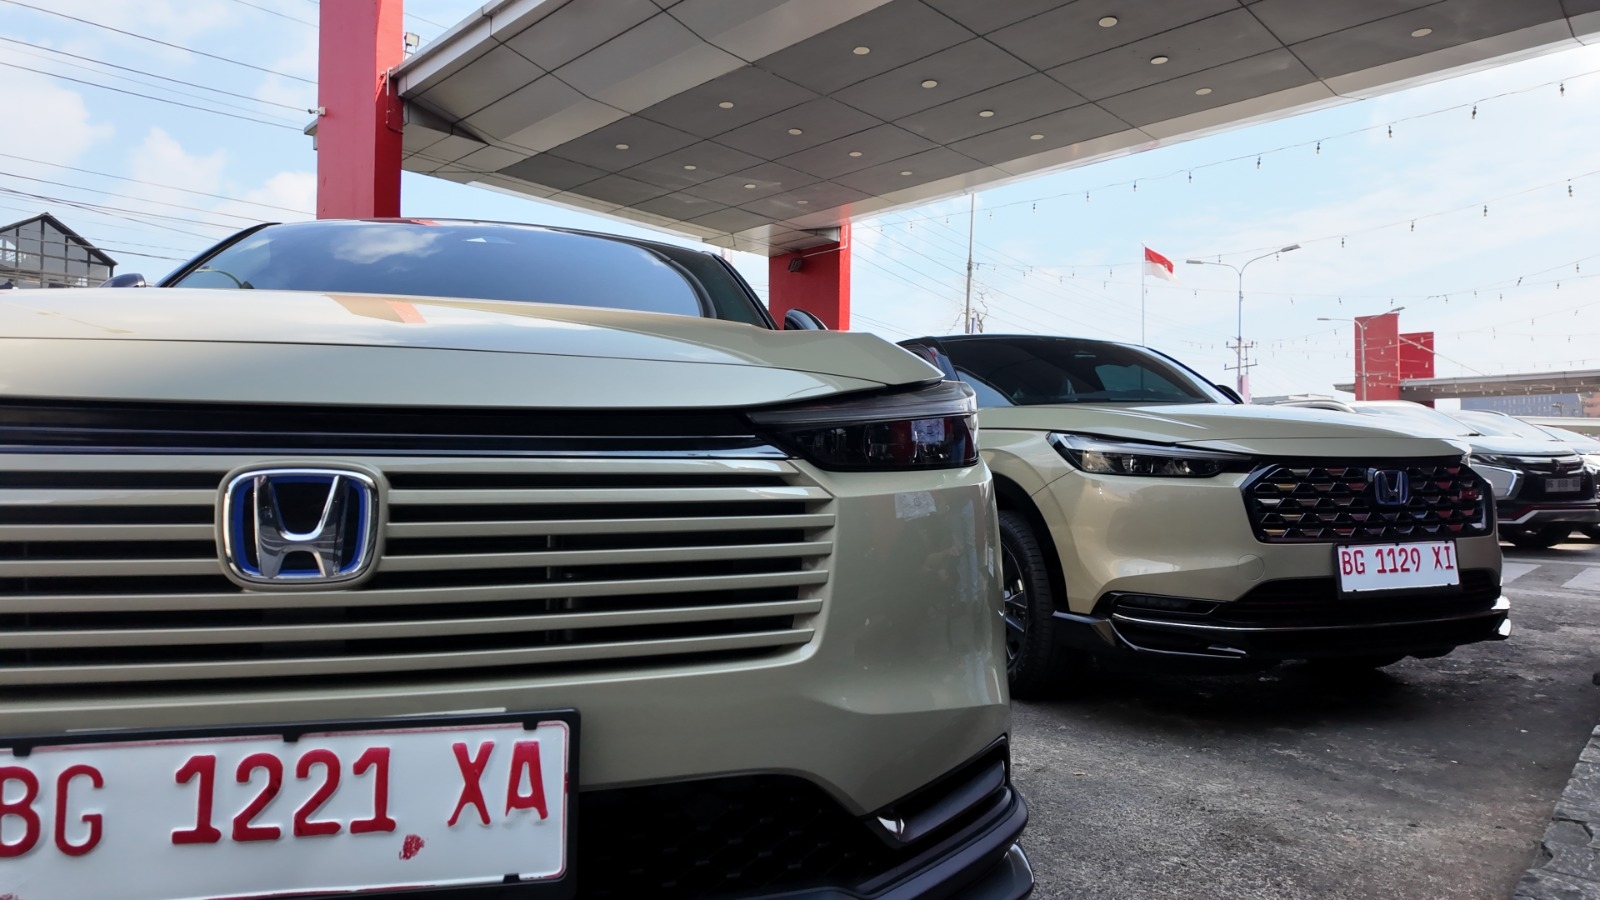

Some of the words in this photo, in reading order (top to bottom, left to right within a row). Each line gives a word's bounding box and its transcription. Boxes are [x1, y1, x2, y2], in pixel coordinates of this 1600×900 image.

[1341, 550, 1366, 575] BG
[1375, 547, 1421, 573] 1129
[1432, 546, 1454, 570] XI
[0, 764, 104, 858] BG
[171, 747, 397, 845] 1221
[447, 740, 549, 827] XA
